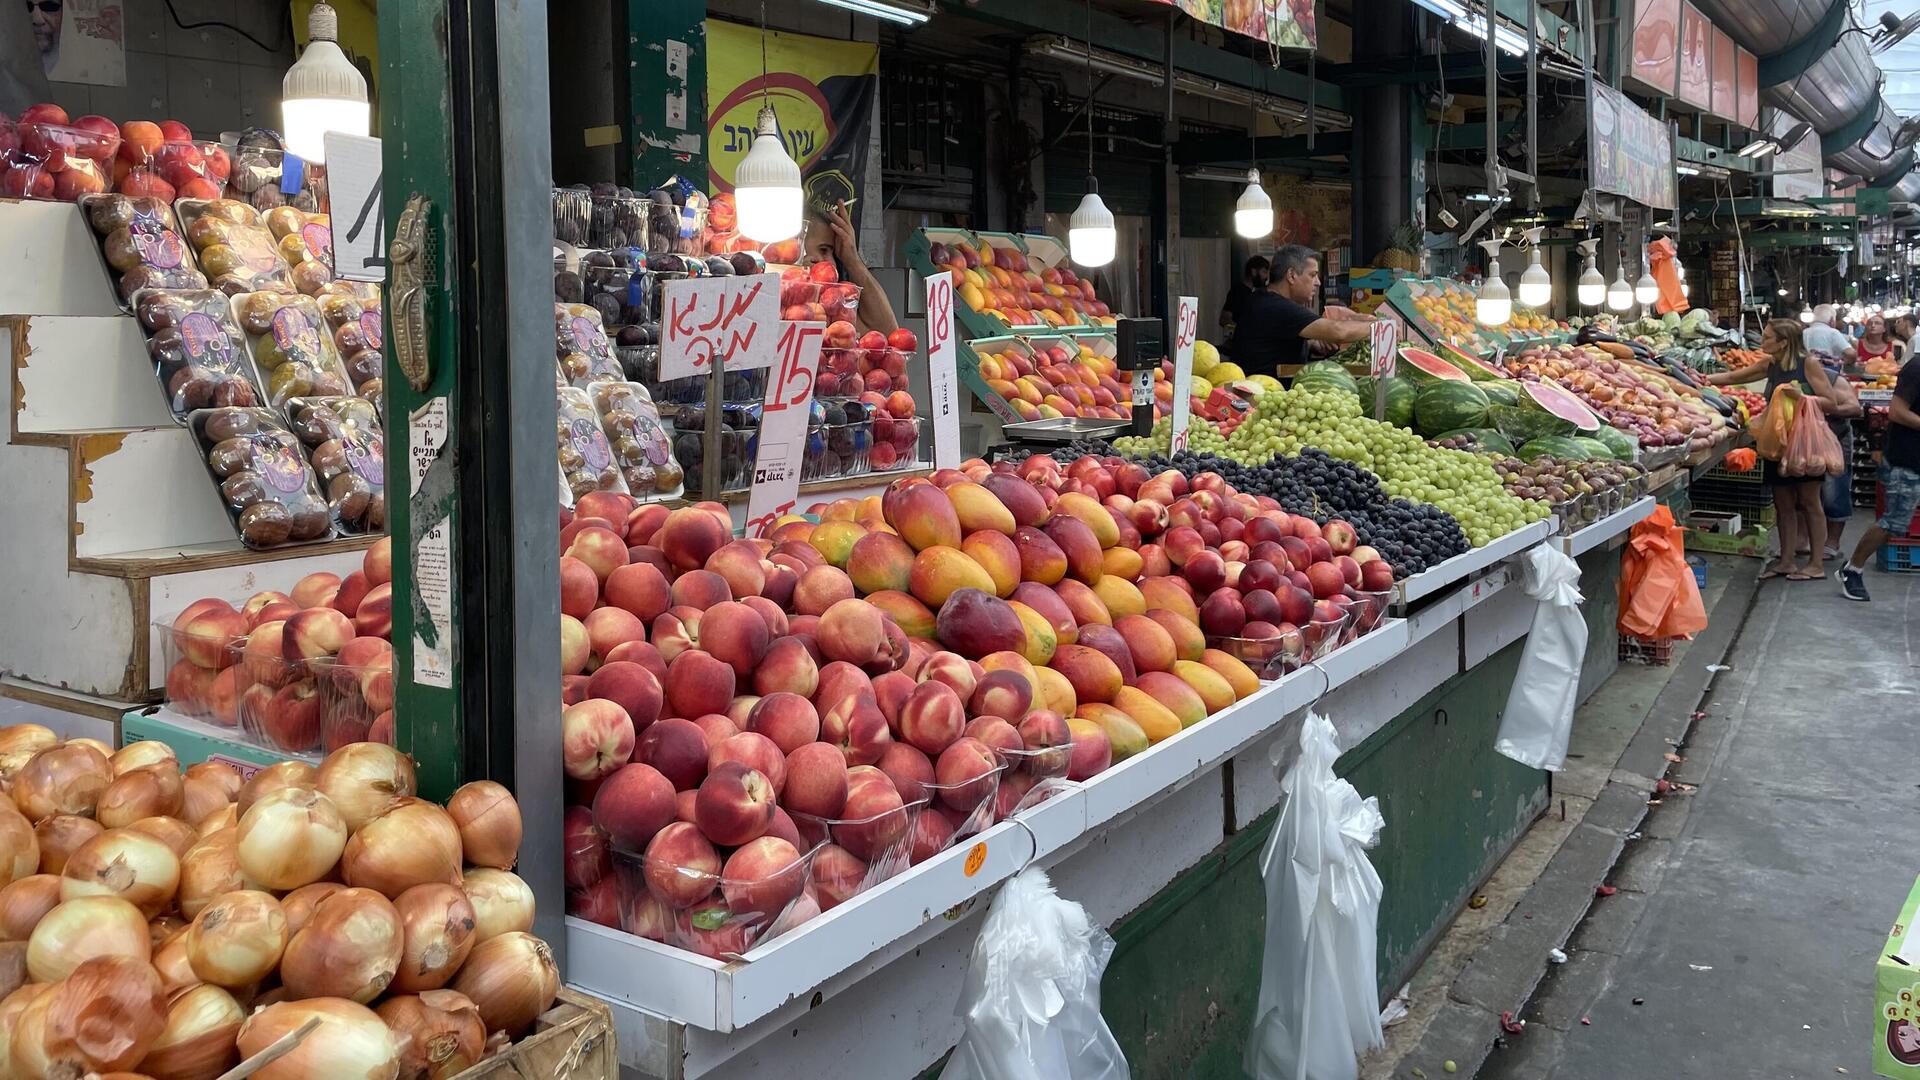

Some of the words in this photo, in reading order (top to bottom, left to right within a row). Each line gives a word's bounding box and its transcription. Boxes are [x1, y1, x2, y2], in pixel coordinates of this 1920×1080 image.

[787, 128, 815, 162] עין
[928, 279, 950, 356] 18
[1177, 302, 1198, 350] 20
[763, 321, 823, 412] 15
[424, 430, 434, 446] אל
